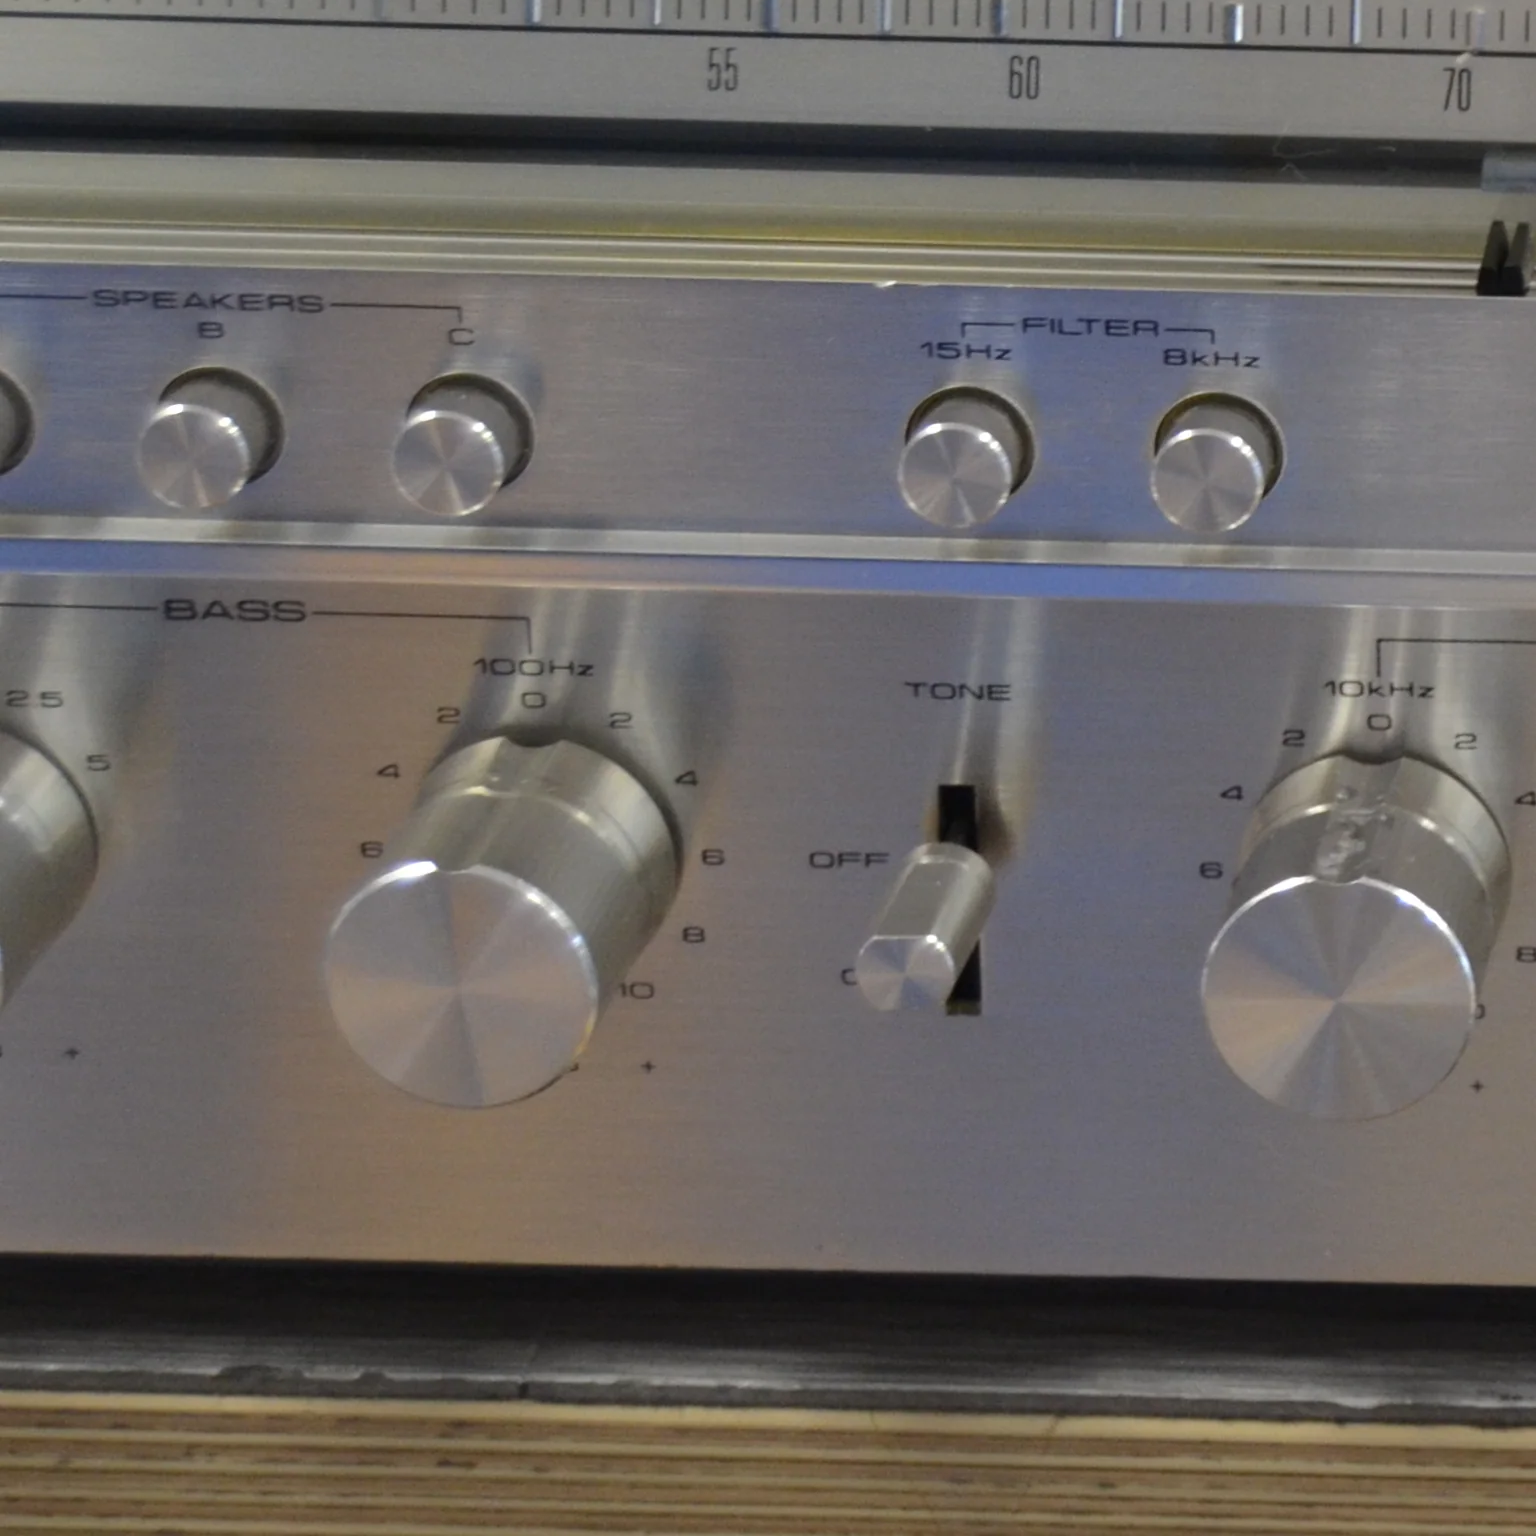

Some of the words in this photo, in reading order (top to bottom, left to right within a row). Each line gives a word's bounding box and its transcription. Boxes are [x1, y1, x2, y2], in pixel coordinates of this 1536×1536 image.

[706, 47, 738, 91] 55
[1008, 55, 1040, 100] 60
[1443, 68, 1471, 112] 70
[93, 289, 325, 313] SPEAKERS
[199, 321, 224, 339] B
[448, 328, 474, 346] C
[1021, 317, 1160, 337] FILTER
[920, 342, 1013, 361] 15Hz
[1163, 348, 1261, 368] 8kHz
[162, 599, 307, 623] BASS
[472, 658, 594, 677] 100Hz
[904, 681, 1012, 701] TONE
[1323, 680, 1435, 699] 10kHz
[521, 691, 546, 709] 0
[437, 706, 461, 724] 2
[609, 712, 632, 729] 2
[86, 754, 111, 772] 5
[376, 763, 401, 779] 4
[675, 770, 698, 786] 4
[1199, 862, 1223, 880] 6
[1220, 785, 1244, 802] 4
[1281, 729, 1306, 748] 2
[1367, 714, 1392, 732] 0
[1455, 733, 1478, 751] 2
[360, 841, 384, 859] 6
[702, 849, 725, 865] 6
[808, 851, 890, 869] OFF
[682, 926, 706, 944] 8
[618, 982, 655, 1000] 10
